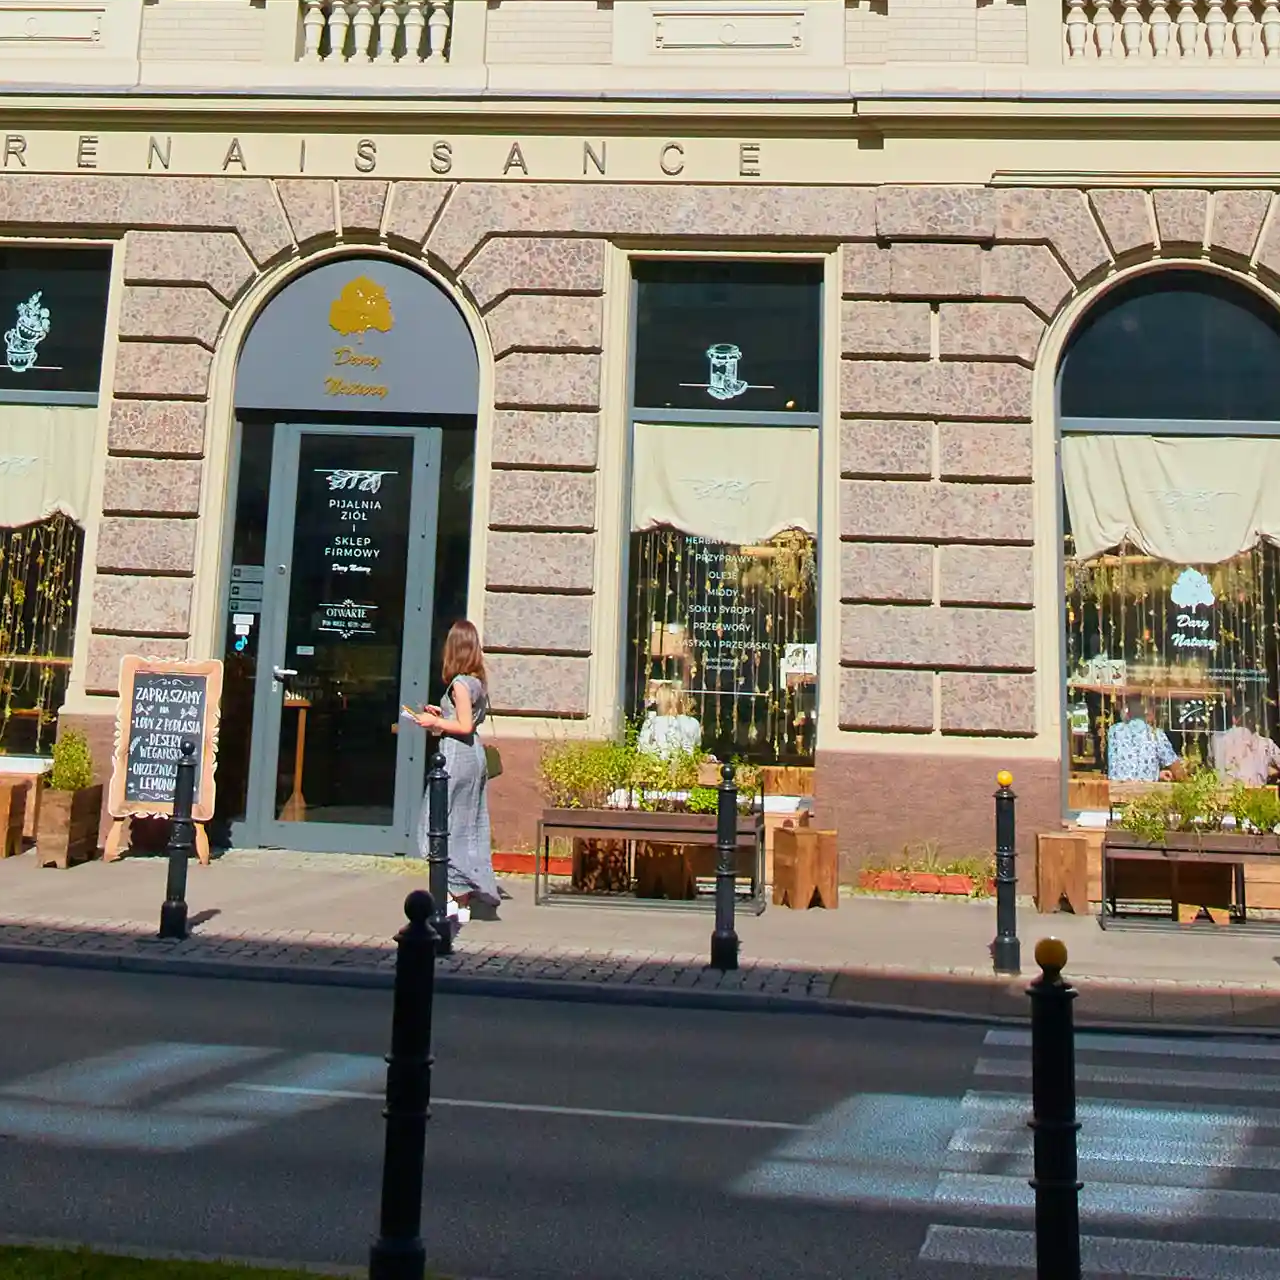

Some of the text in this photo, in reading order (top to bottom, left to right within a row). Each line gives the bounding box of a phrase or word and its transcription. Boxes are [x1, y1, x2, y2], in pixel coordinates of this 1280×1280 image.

[2, 135, 762, 177] RENAISSANCE
[329, 499, 382, 509] PIJALNIA
[334, 536, 371, 546] SKLEP
[324, 548, 380, 558] FIRMOWY
[688, 604, 711, 613] SOKI
[693, 622, 751, 632] PRZEWORY
[1176, 614, 1210, 631] Dary
[1171, 633, 1218, 651] Natury
[135, 687, 202, 704] ZAPRASZAMY
